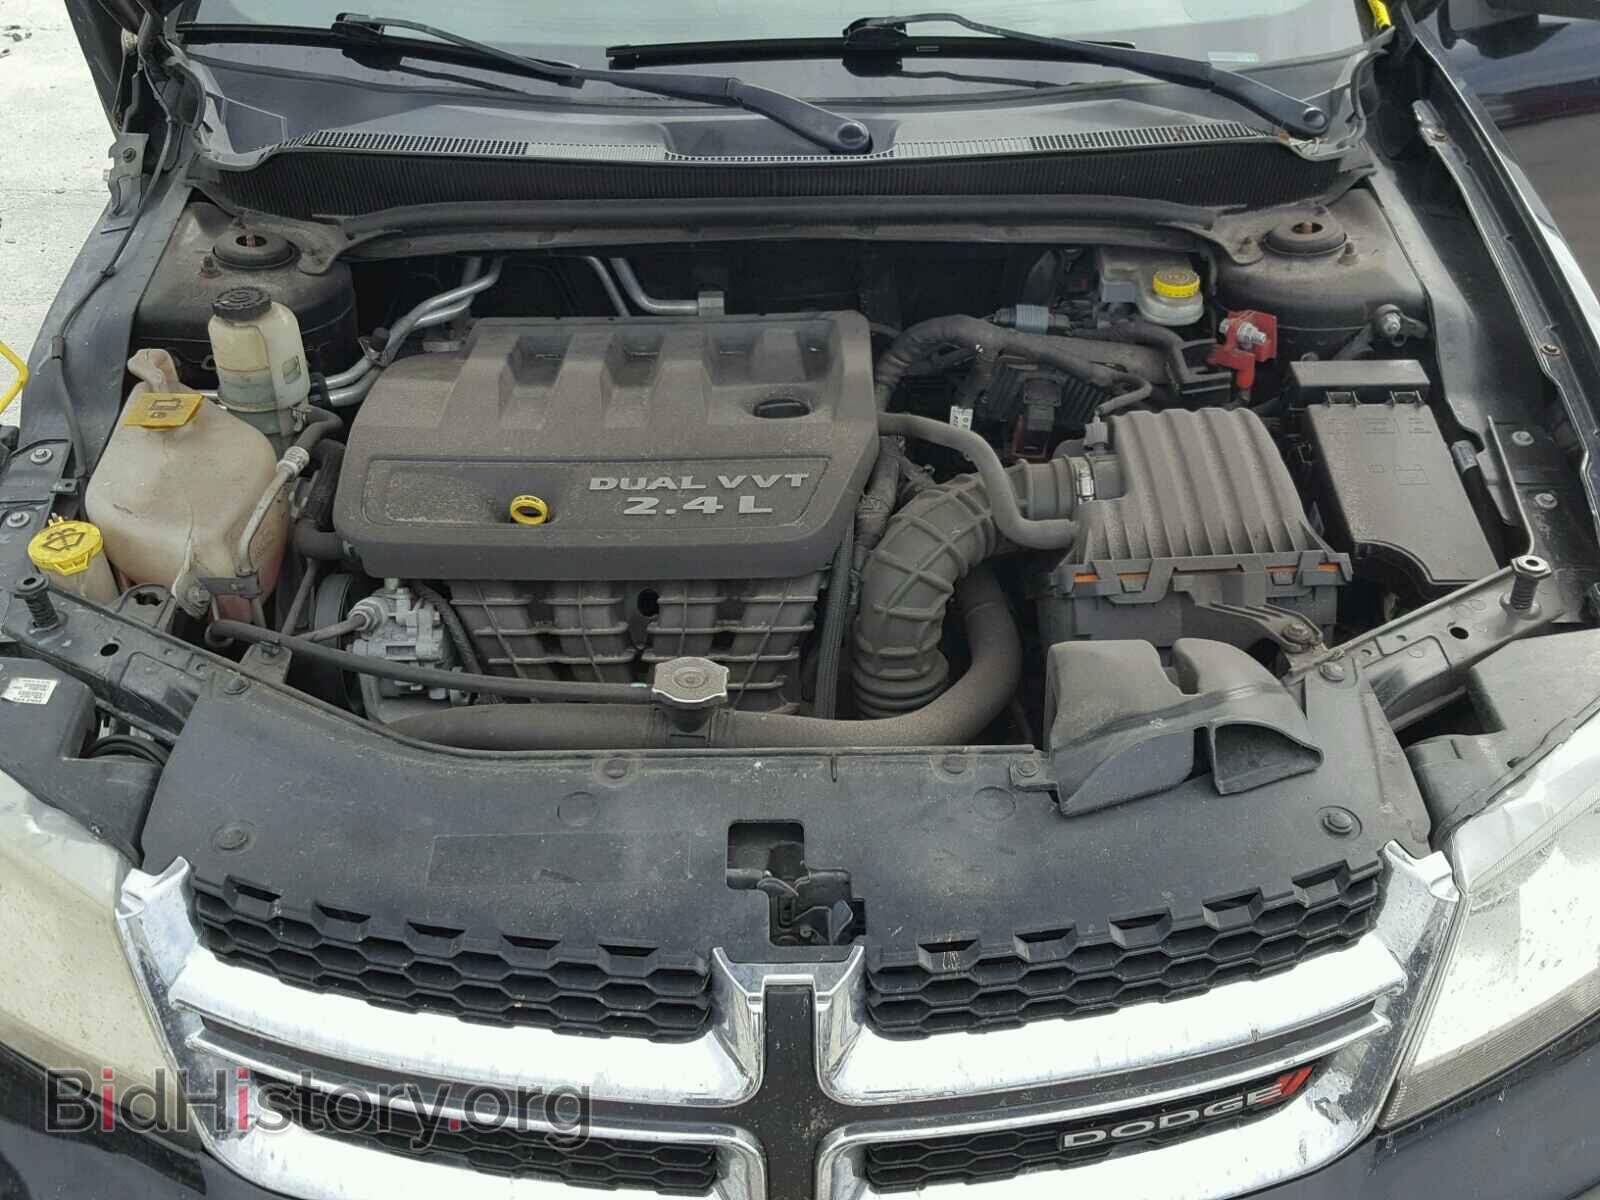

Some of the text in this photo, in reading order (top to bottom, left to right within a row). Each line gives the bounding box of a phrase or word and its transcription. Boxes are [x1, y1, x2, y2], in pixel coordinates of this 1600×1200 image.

[589, 473, 809, 491] DUAL VVT
[1063, 1083, 1283, 1148] DODGE
